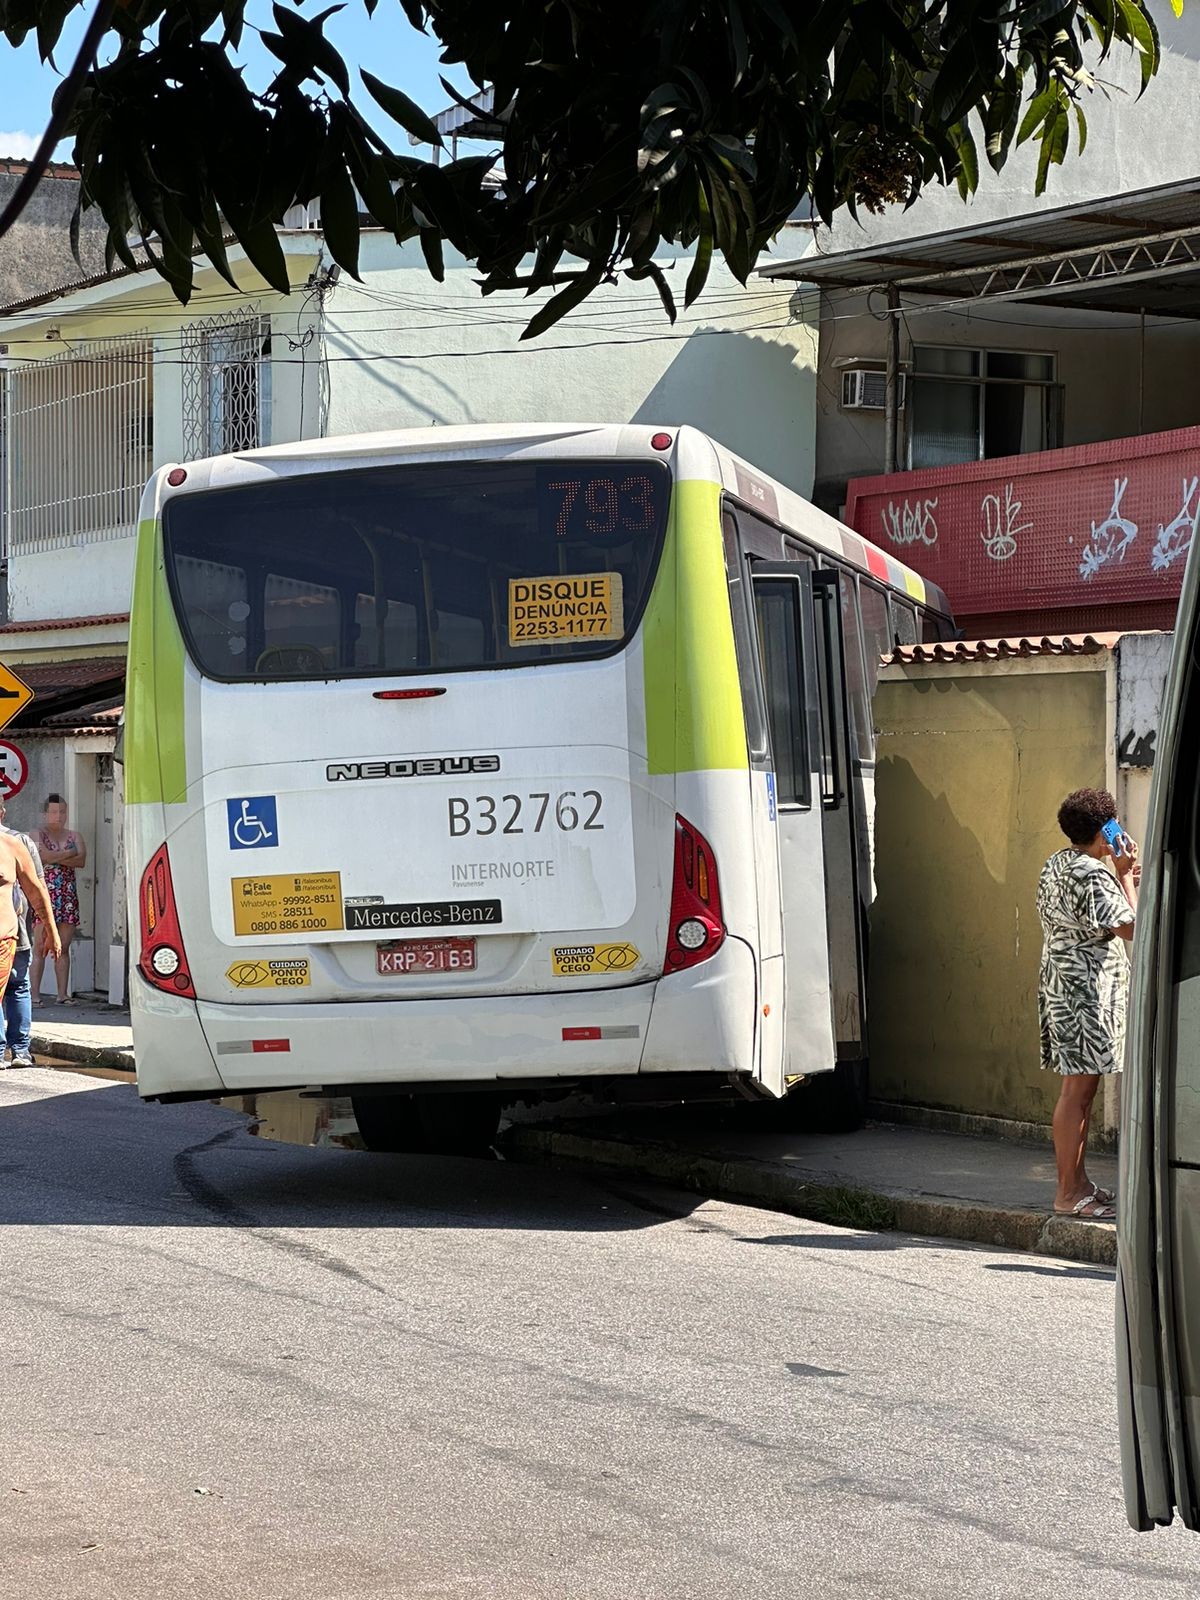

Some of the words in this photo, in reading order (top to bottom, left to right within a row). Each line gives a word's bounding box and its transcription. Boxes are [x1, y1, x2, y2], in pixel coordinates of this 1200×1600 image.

[548, 476, 655, 536] 793
[514, 580, 605, 603] DISQUE
[514, 600, 607, 620] DENÚNCIA
[515, 618, 608, 637] 2253-1177
[326, 755, 500, 782] NEOBUS
[448, 790, 604, 837] B32762
[451, 860, 555, 881] INTERNORTE
[253, 882, 272, 891] Fale
[240, 898, 278, 908] WhatsApp
[282, 894, 336, 906] 99992-8511
[260, 911, 277, 919] SMS
[283, 907, 314, 917] 28511
[353, 905, 495, 928] Mercedes-Benz
[250, 921, 277, 932] 0800
[279, 920, 299, 930] 886
[302, 918, 327, 929] 1000
[556, 947, 594, 955] CUIDADO
[380, 952, 416, 971] KRP
[425, 950, 473, 968] 2163
[556, 955, 594, 964] PONTO
[270, 968, 307, 977] PONTO
[560, 964, 591, 973] CEGO
[275, 977, 304, 986] CEGO
